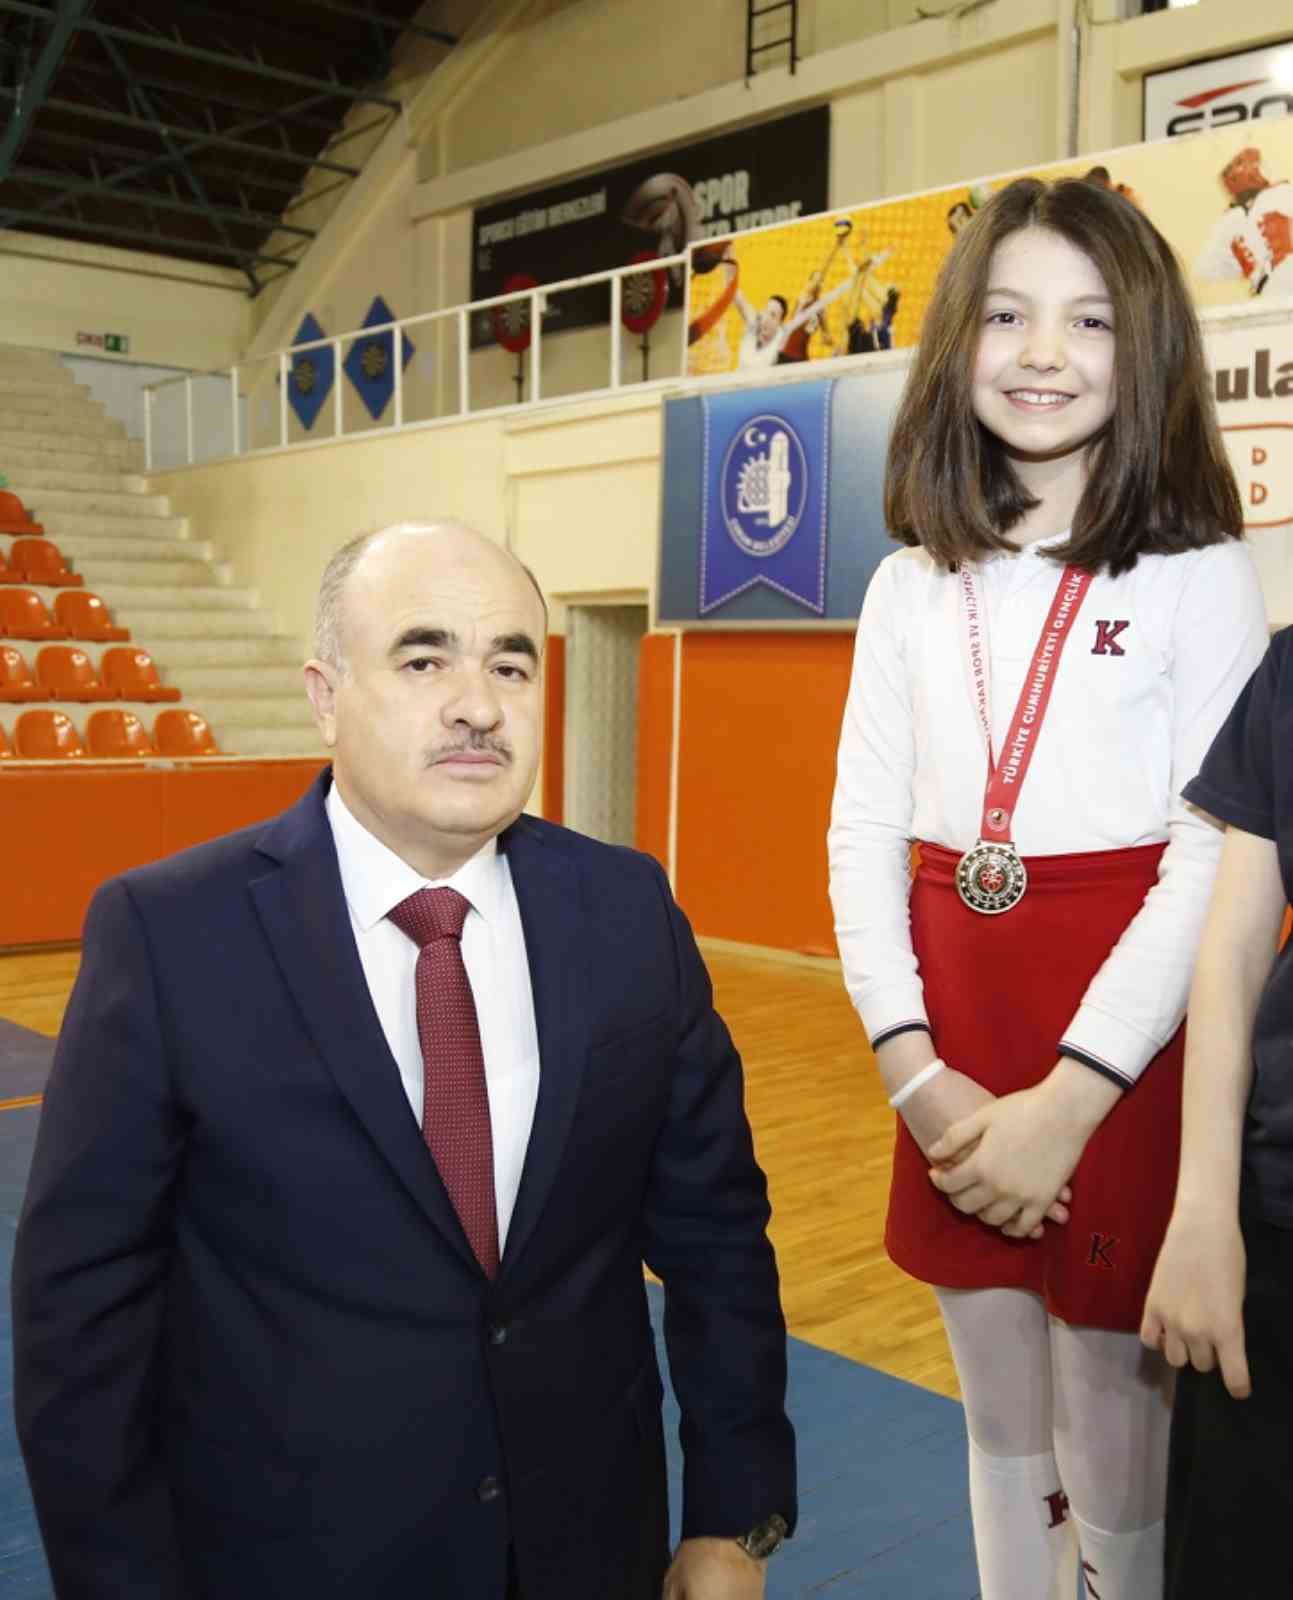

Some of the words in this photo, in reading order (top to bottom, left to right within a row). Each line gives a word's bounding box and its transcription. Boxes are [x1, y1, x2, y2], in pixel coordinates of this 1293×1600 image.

[1091, 620, 1130, 656] K
[1001, 727, 1030, 785] TÜRKİYE
[1089, 1231, 1120, 1269] K
